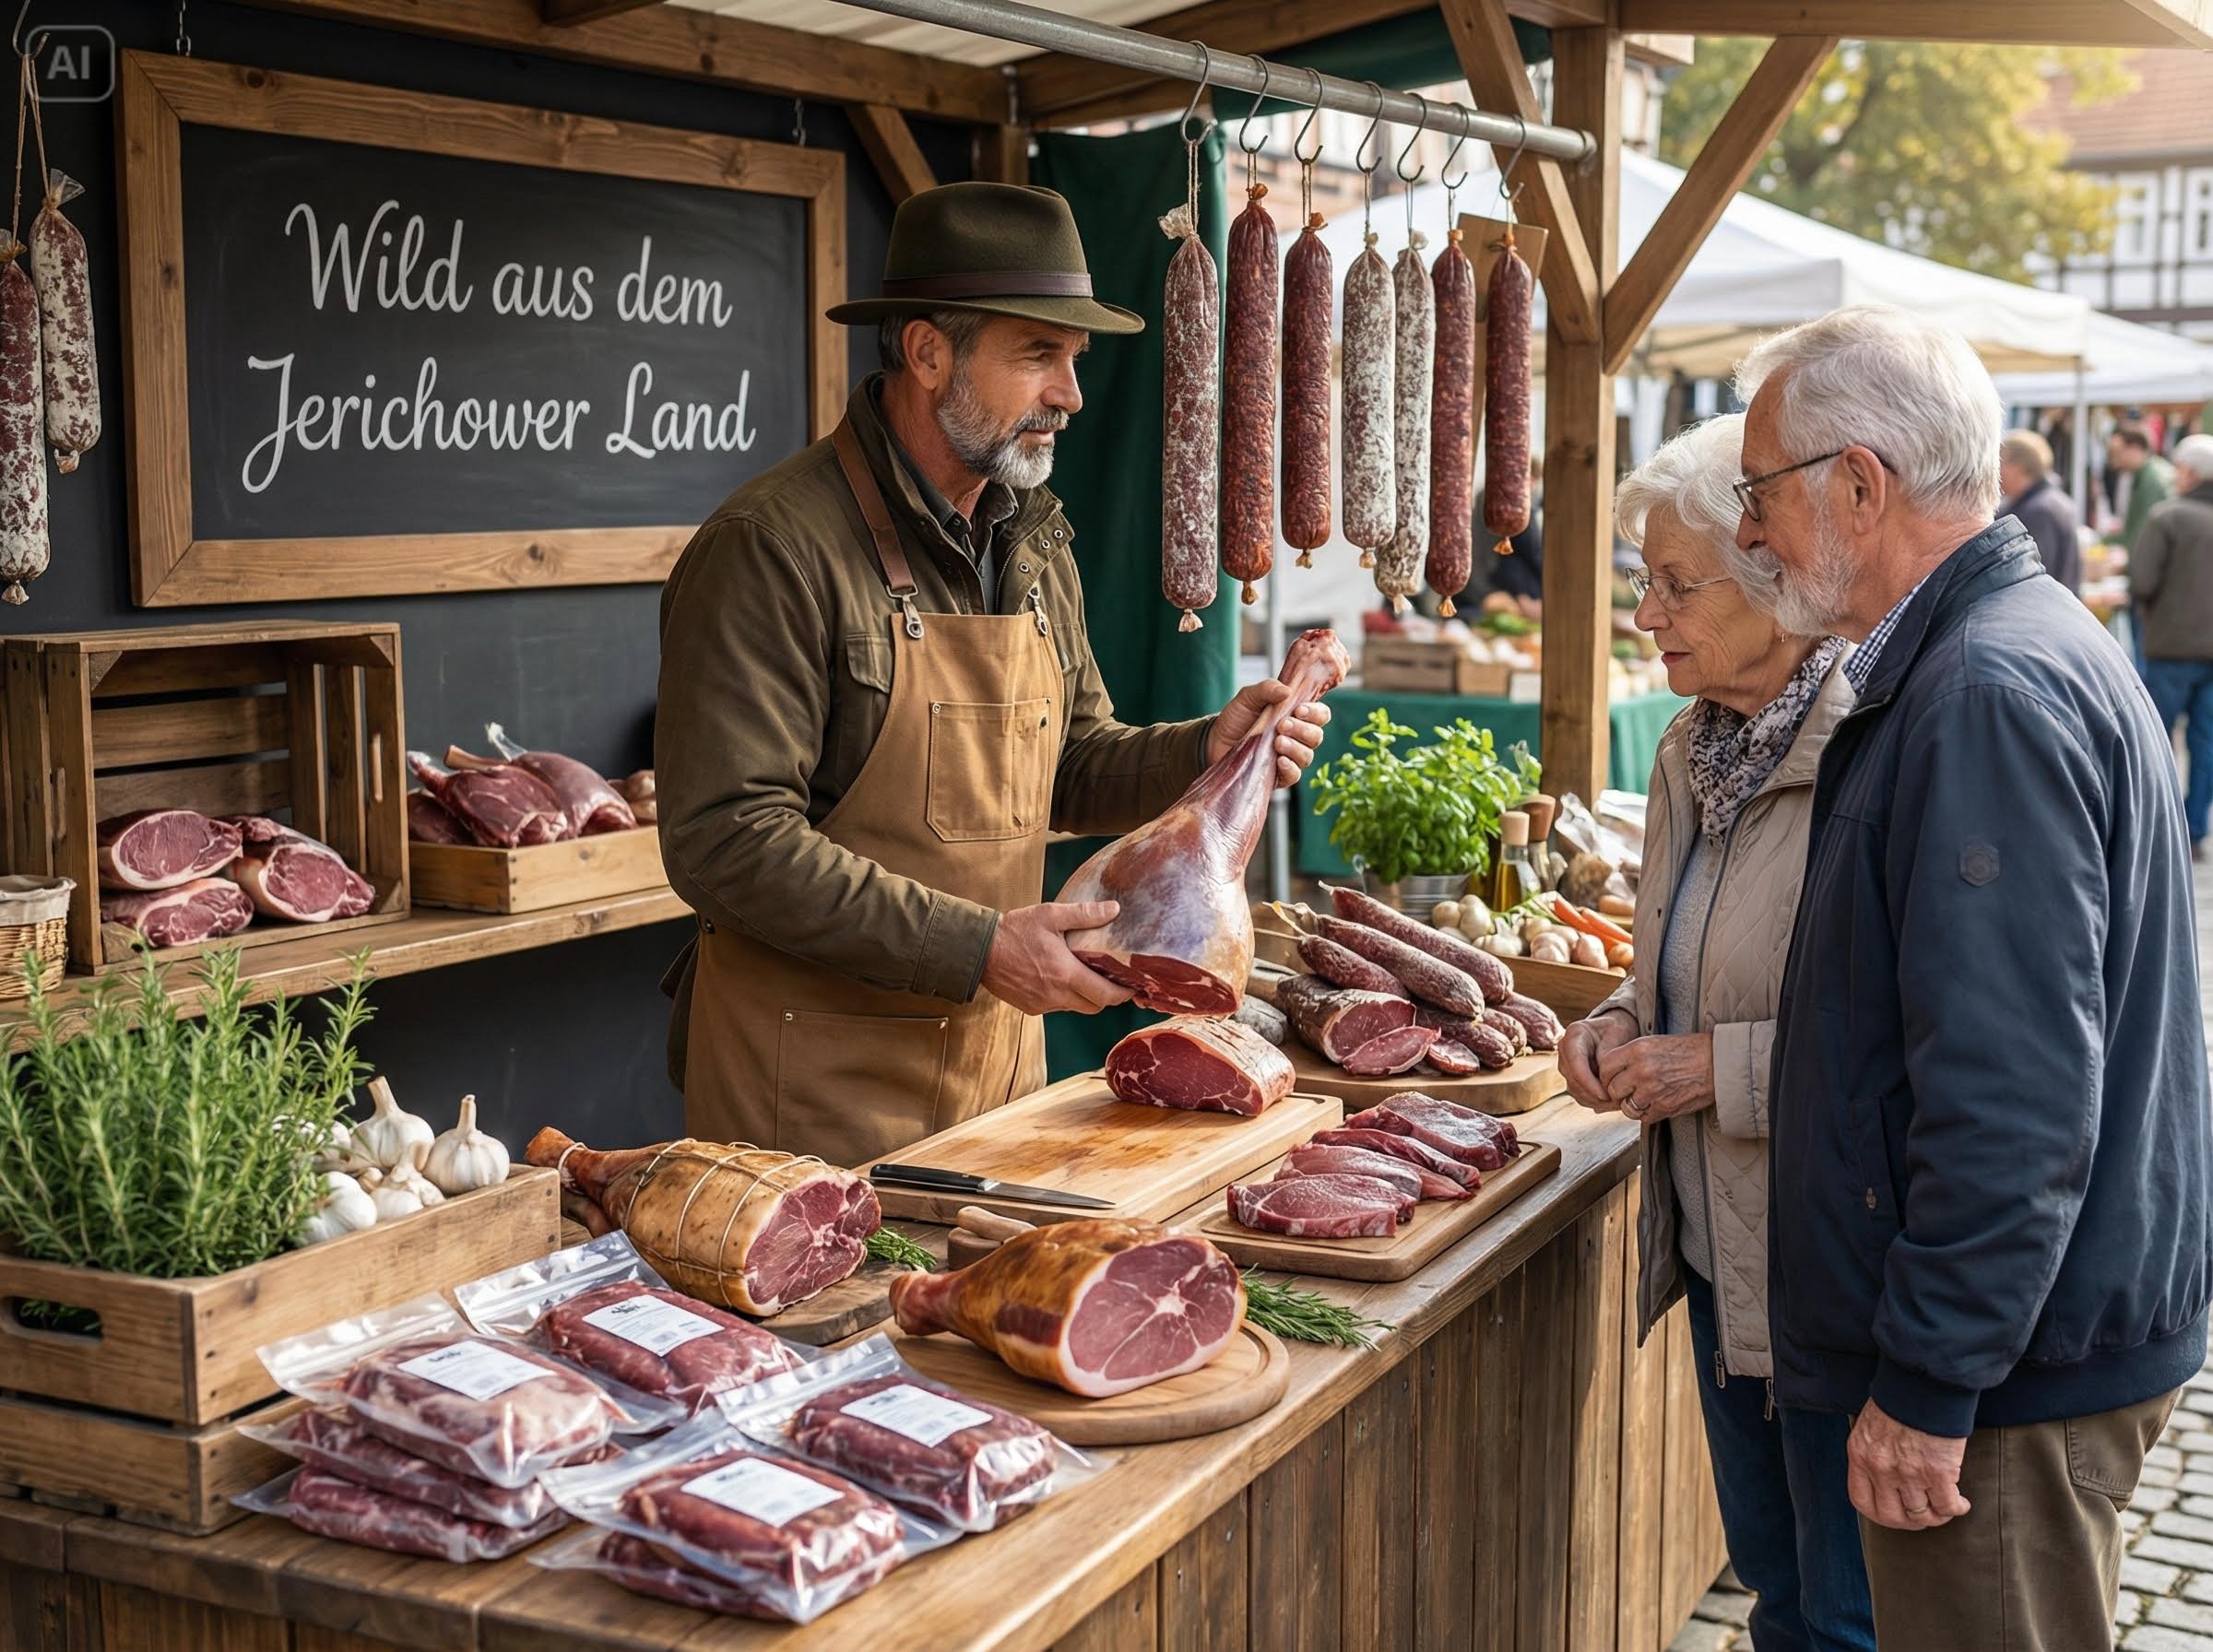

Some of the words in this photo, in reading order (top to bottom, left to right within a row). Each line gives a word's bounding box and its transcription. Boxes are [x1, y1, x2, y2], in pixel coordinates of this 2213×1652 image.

[284, 199, 473, 314] Wild
[491, 262, 595, 322] aus
[616, 235, 734, 329] dem
[242, 352, 592, 495] Jerichower
[604, 360, 758, 460] Land
